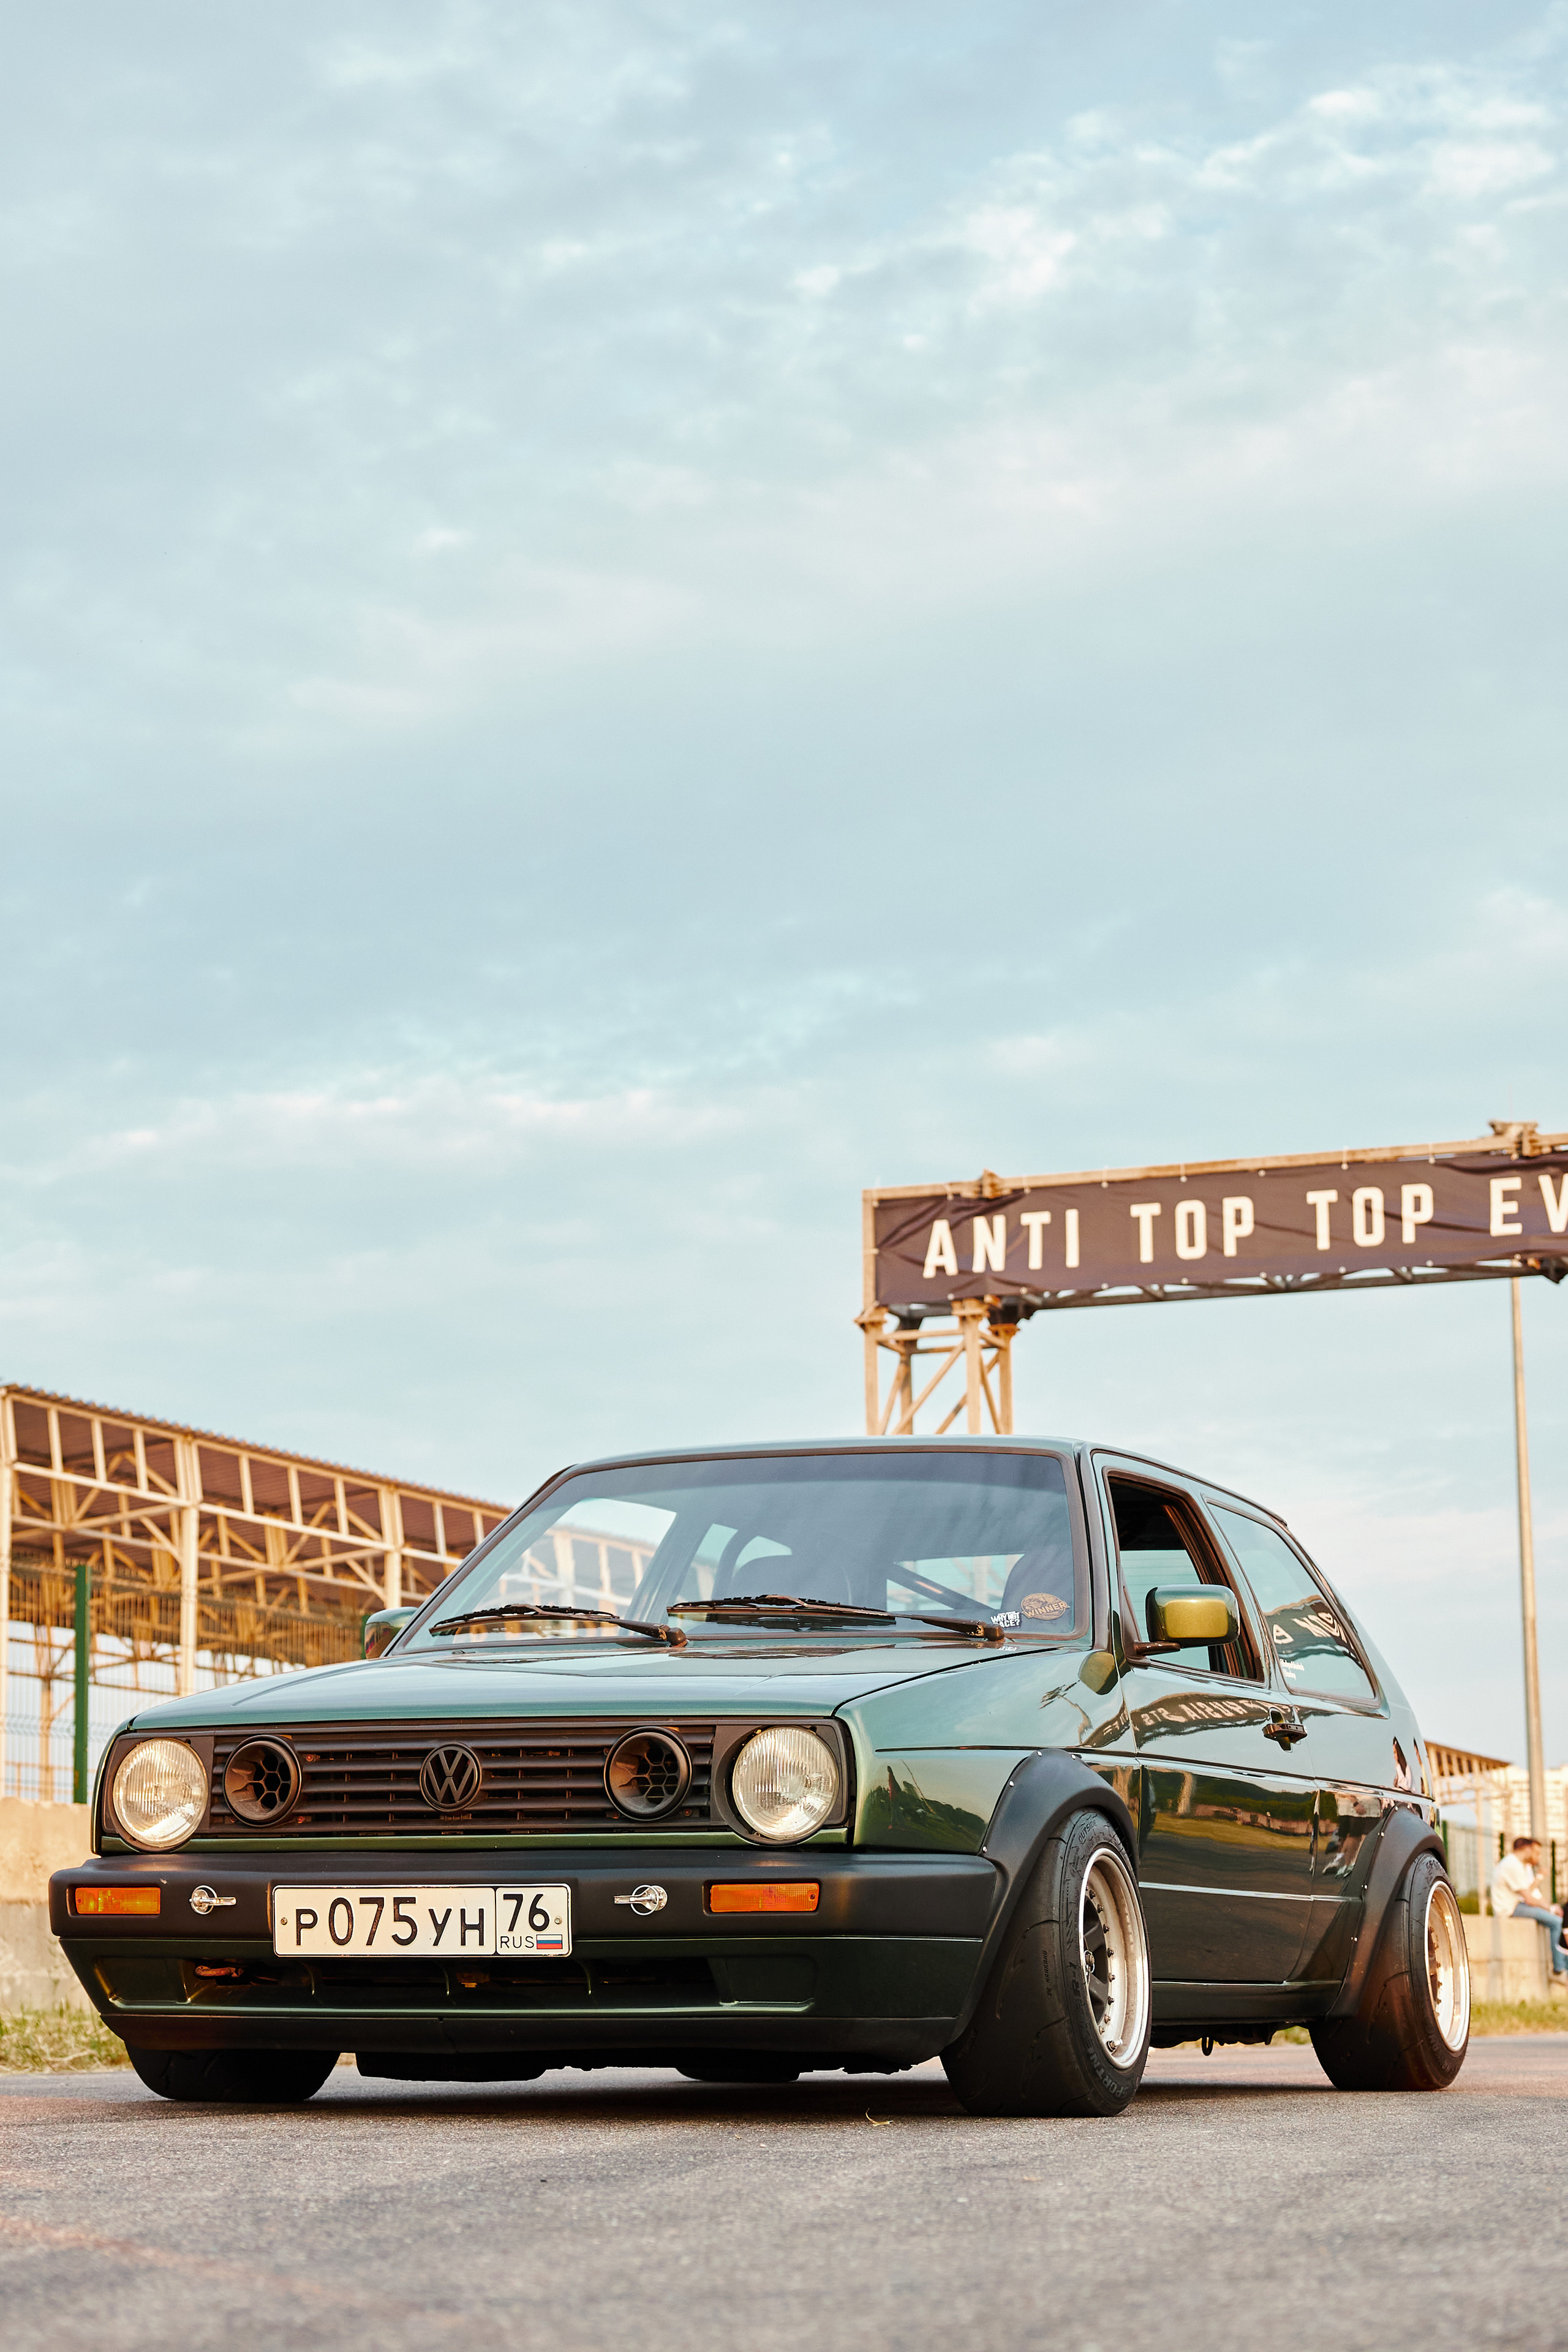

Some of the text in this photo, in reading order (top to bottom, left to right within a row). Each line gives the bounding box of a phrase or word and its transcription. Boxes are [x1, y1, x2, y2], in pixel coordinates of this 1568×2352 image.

[923, 1173, 1568, 1278] ANTI TOP TOP EV
[990, 1613, 1006, 1623] WHY
[1006, 1611, 1020, 1621] NOT
[1024, 1602, 1067, 1617] WINNER
[993, 1619, 1020, 1628] ACE?
[423, 1747, 476, 1804] VW
[1078, 1819, 1098, 1844] OUTSIDE
[503, 1893, 550, 1932] 76
[500, 1936, 535, 1949] RUS
